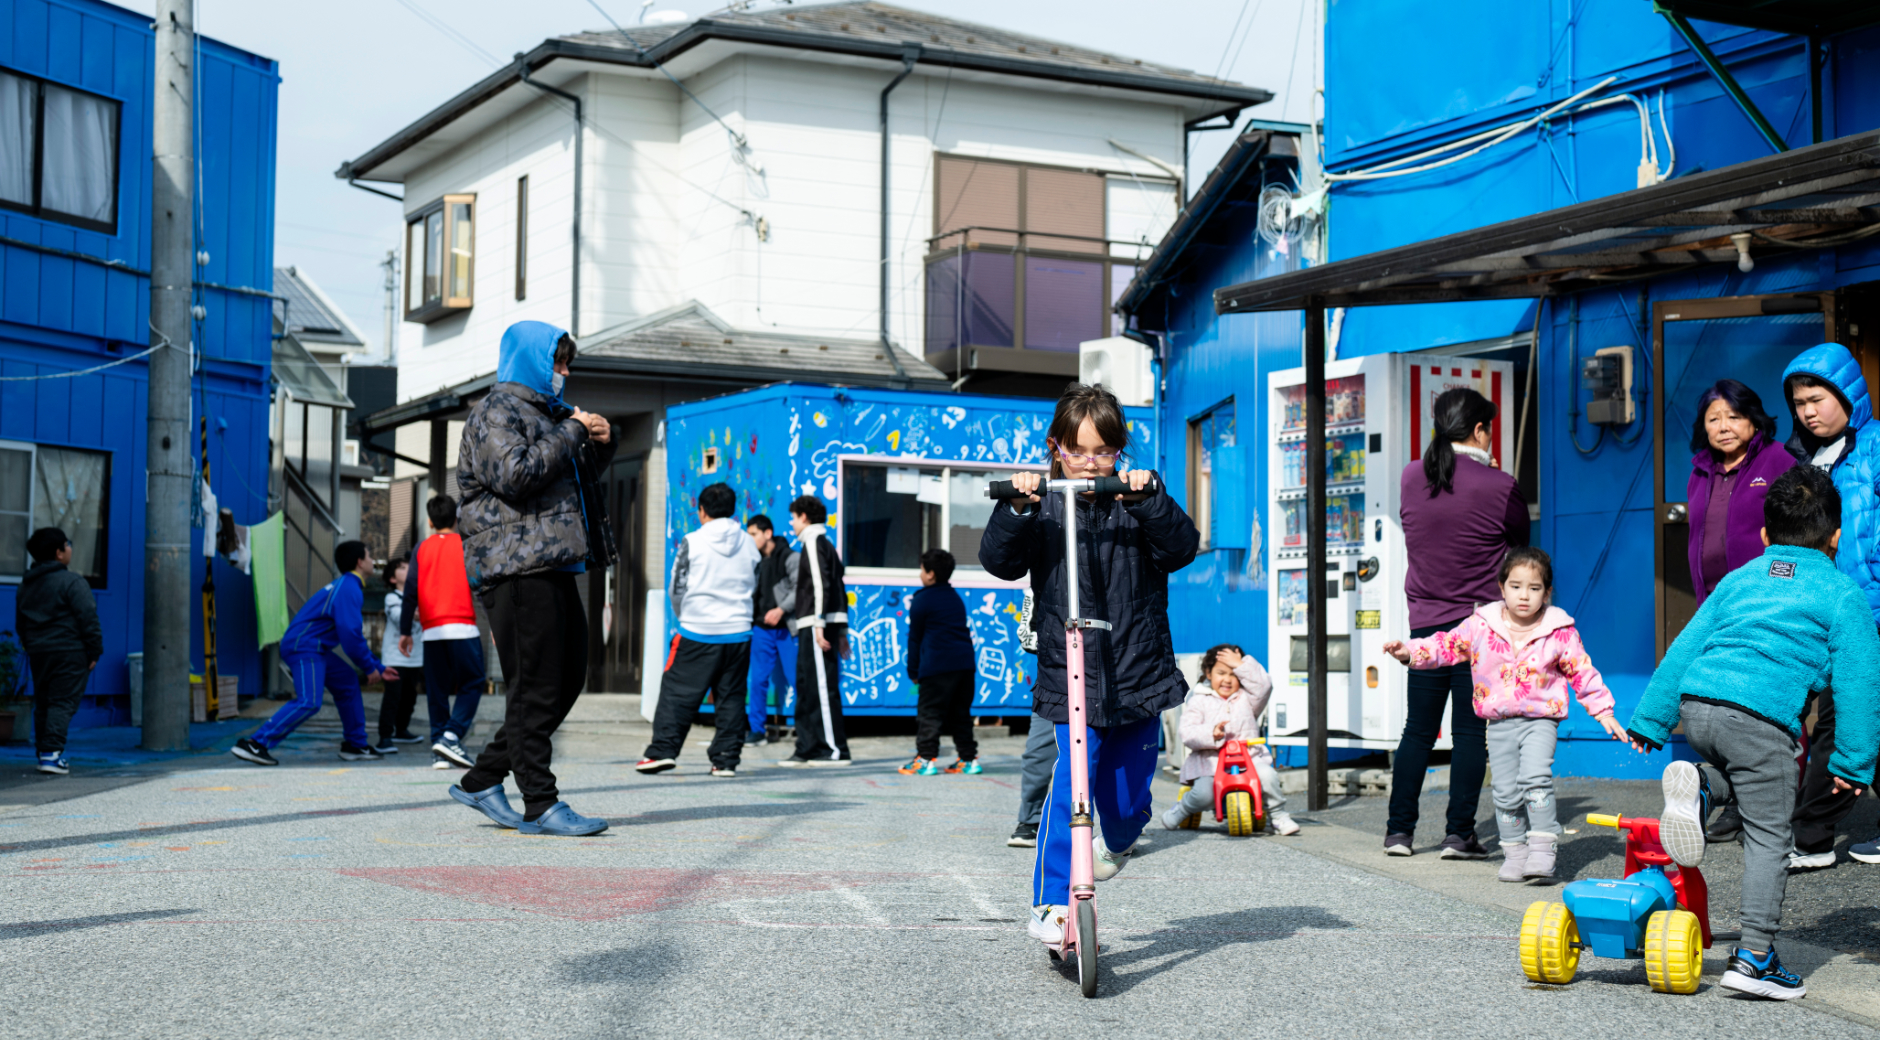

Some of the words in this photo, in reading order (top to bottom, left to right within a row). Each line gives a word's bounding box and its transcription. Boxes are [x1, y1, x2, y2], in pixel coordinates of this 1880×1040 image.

[941, 406, 966, 430] 13
[960, 444, 969, 460] 9
[976, 444, 987, 460] 7
[822, 476, 837, 500] 6
[887, 591, 900, 608] 5
[980, 591, 997, 616] 1
[885, 674, 899, 692] 2
[870, 686, 878, 700] 3
[979, 682, 991, 704] 4
